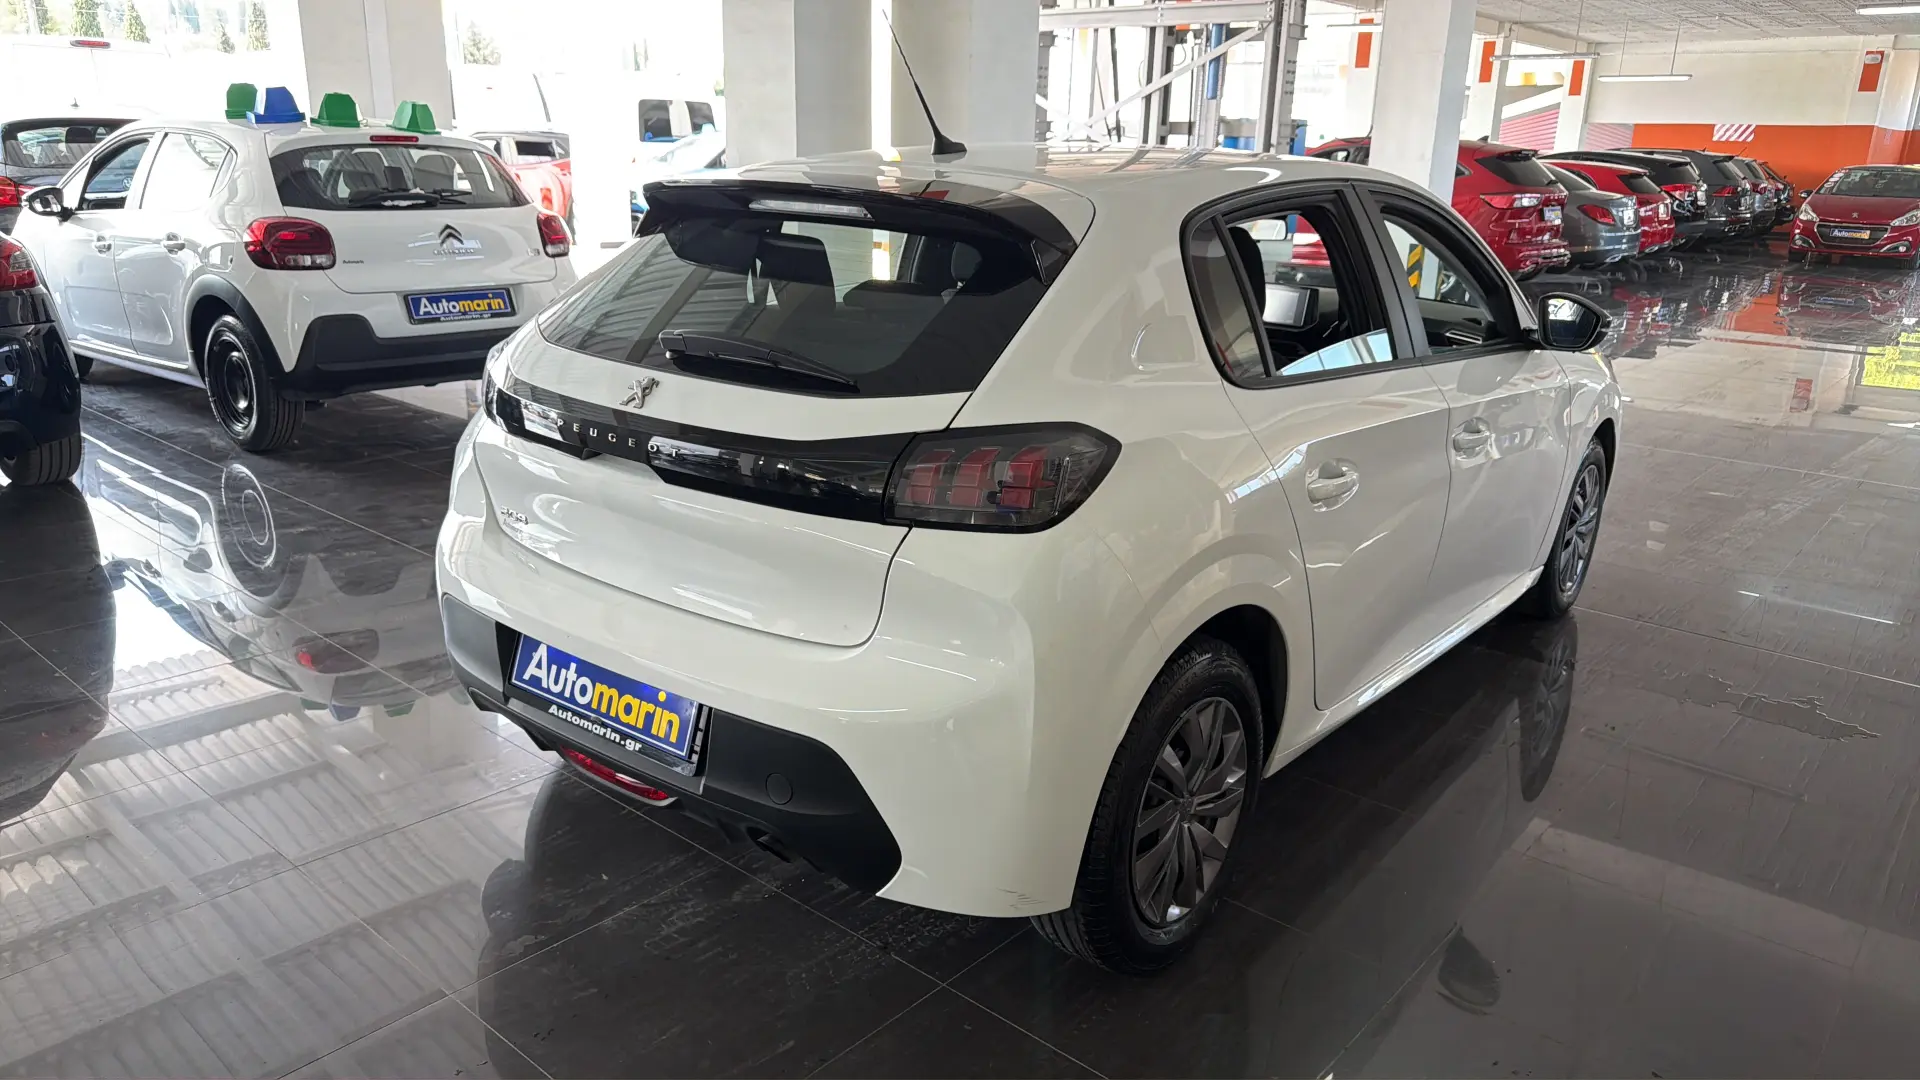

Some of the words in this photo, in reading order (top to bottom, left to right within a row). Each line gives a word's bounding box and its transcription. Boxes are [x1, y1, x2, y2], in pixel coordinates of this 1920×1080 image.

[419, 293, 505, 315] Automarin
[557, 418, 680, 457] PEUGEOT
[523, 643, 681, 744] Automarin
[548, 704, 643, 752] Automarin.gr
